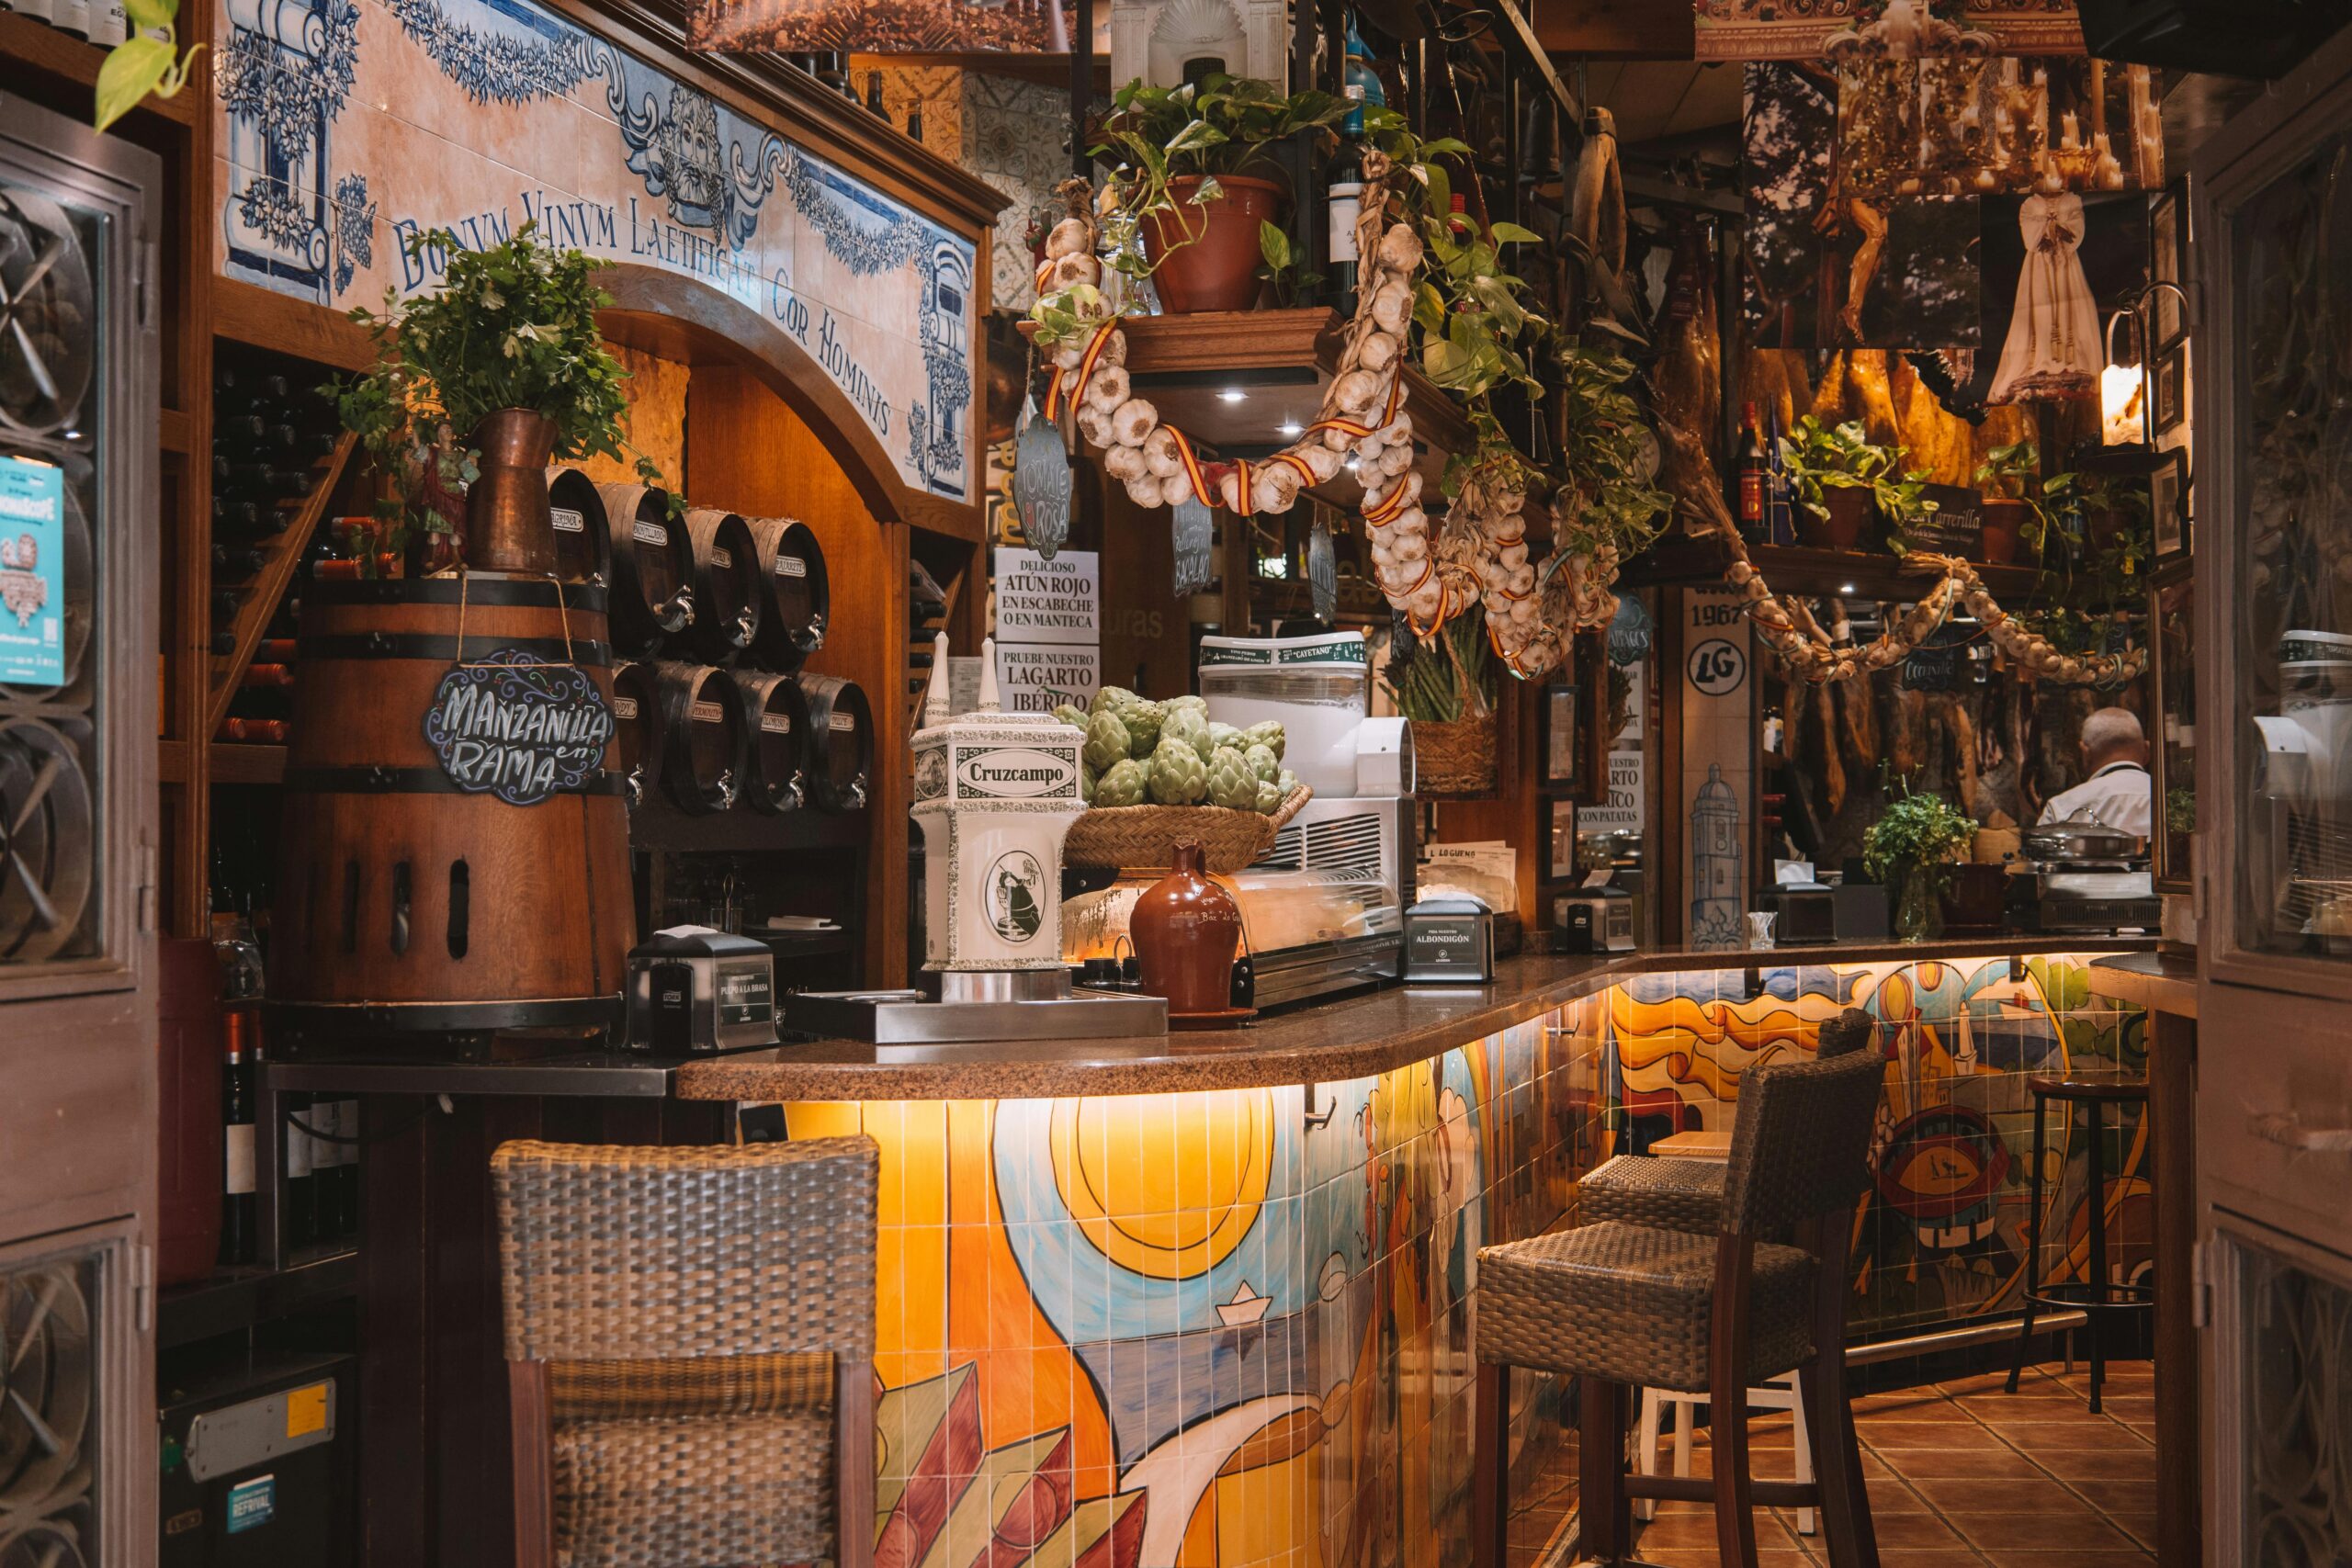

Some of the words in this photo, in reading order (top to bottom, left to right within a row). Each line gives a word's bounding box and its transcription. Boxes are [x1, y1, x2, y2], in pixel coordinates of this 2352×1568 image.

[1035, 500, 1067, 544] ROSA
[1020, 559, 1076, 573] DELICIOSO
[1175, 554, 1211, 591] BACALAO
[1004, 573, 1048, 592] ATÚN
[1051, 578, 1091, 597] ROJO
[1002, 596, 1019, 609] EN
[1021, 597, 1094, 613] ESCABECHE
[1004, 613, 1013, 626] O
[1015, 614, 1032, 626] EN
[1034, 615, 1092, 628] MANTECA
[1691, 604, 1743, 626] 1967
[1003, 652, 1044, 664] PRUEBE
[1046, 653, 1093, 666] NUESTRO
[1695, 646, 1736, 683] LG
[1007, 666, 1092, 687] LAGARTO
[616, 703, 632, 716] NDY
[1012, 690, 1088, 713] IBÉRICO
[442, 683, 607, 744] MANZANILLA
[556, 748, 588, 759] en
[1610, 758, 1640, 768] UESTRO
[449, 741, 556, 795] RAMA
[969, 762, 1064, 786] Cruzcampo
[1577, 811, 1599, 823] CON
[1599, 811, 1637, 823] PATATAS
[1416, 934, 1470, 943] ALBONDIGÓN
[720, 986, 739, 996] PULPO
[743, 985, 751, 993] LA
[752, 983, 768, 993] BRASA
